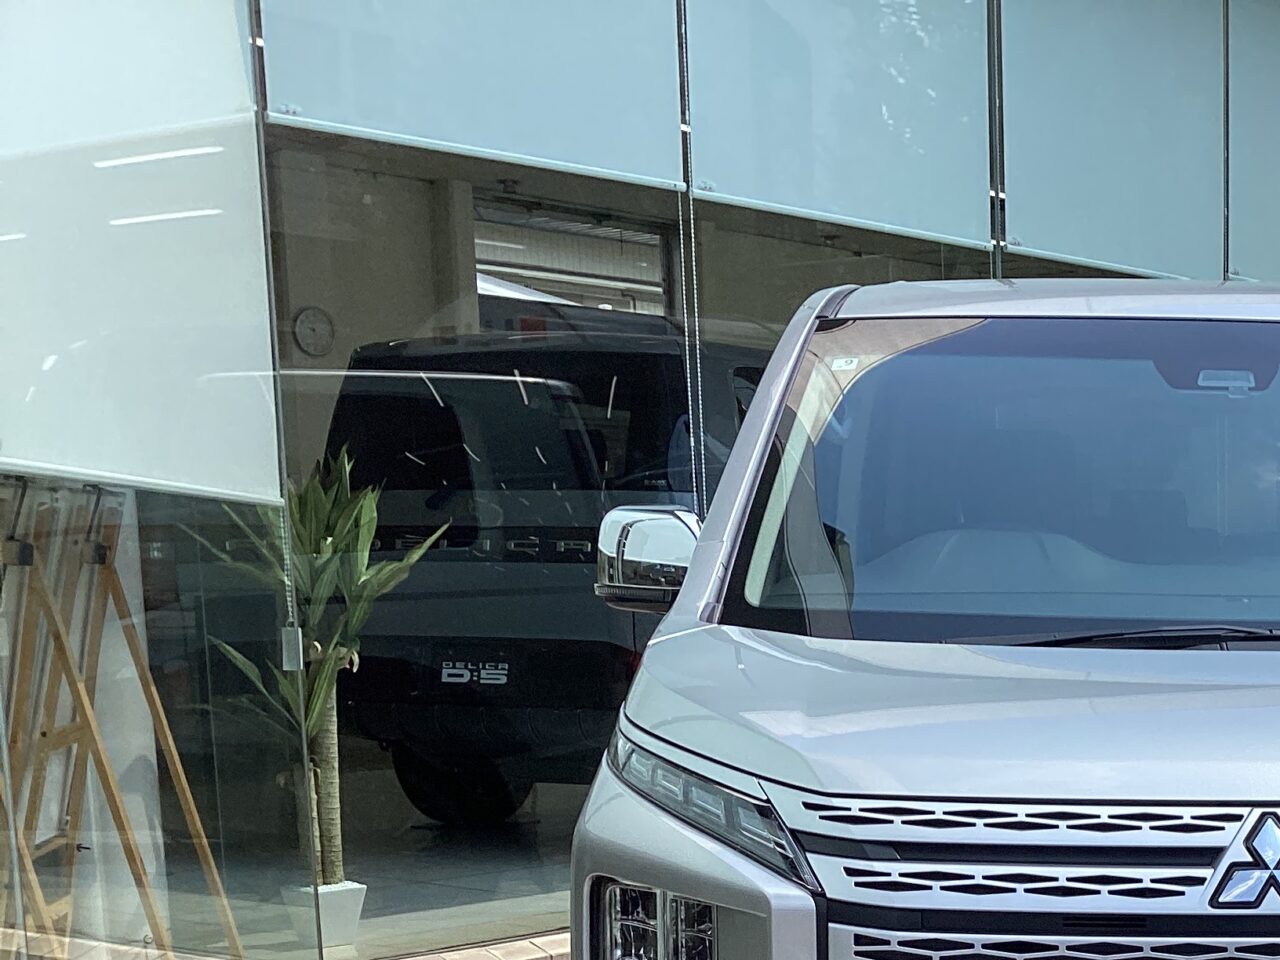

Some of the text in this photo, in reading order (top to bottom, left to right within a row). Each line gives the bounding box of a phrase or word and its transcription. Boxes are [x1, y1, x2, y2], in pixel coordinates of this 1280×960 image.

[374, 538, 593, 553] ELICA
[441, 661, 509, 670] DELICA
[441, 668, 509, 685] D:5
